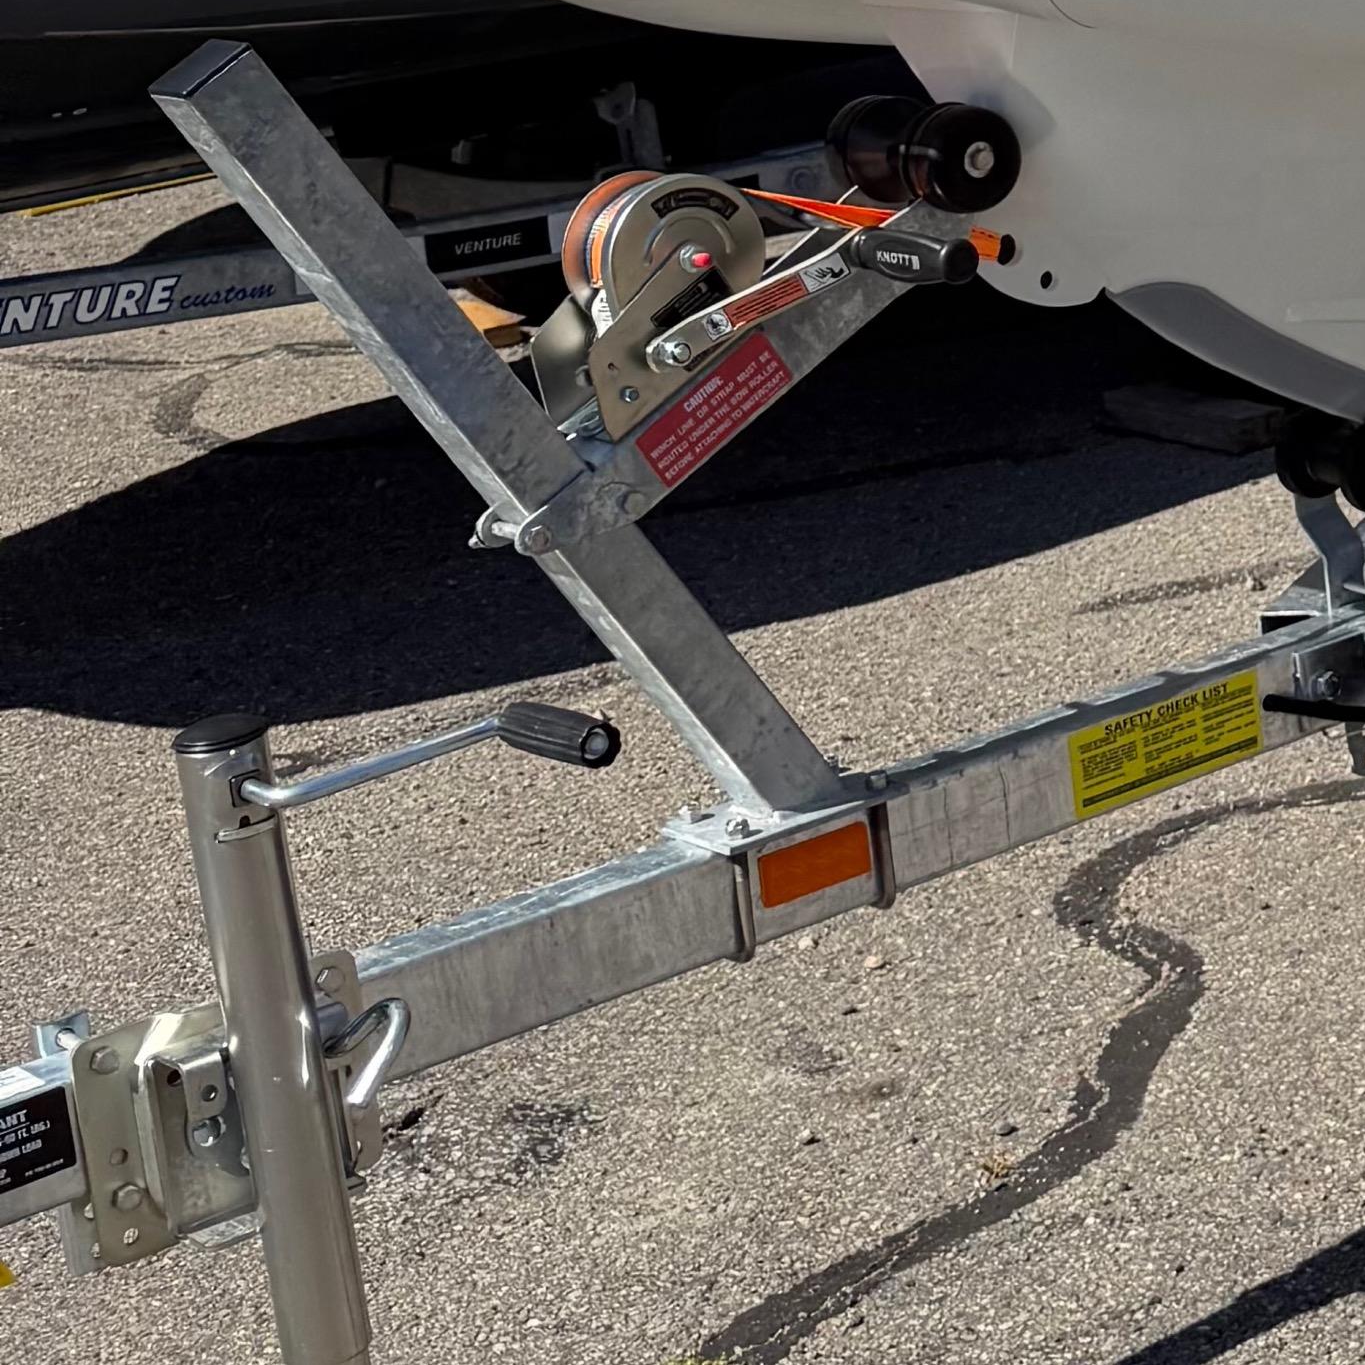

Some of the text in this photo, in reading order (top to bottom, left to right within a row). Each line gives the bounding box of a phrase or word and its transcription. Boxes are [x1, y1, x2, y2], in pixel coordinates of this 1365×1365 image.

[454, 232, 522, 256] VENTURE
[876, 250, 909, 266] KNOTT
[0, 274, 276, 334] NTURE custom
[683, 375, 724, 413] CAUTION:
[1104, 709, 1154, 737] SAFETY
[1156, 692, 1201, 717] CHECK
[1202, 682, 1230, 701] LIST
